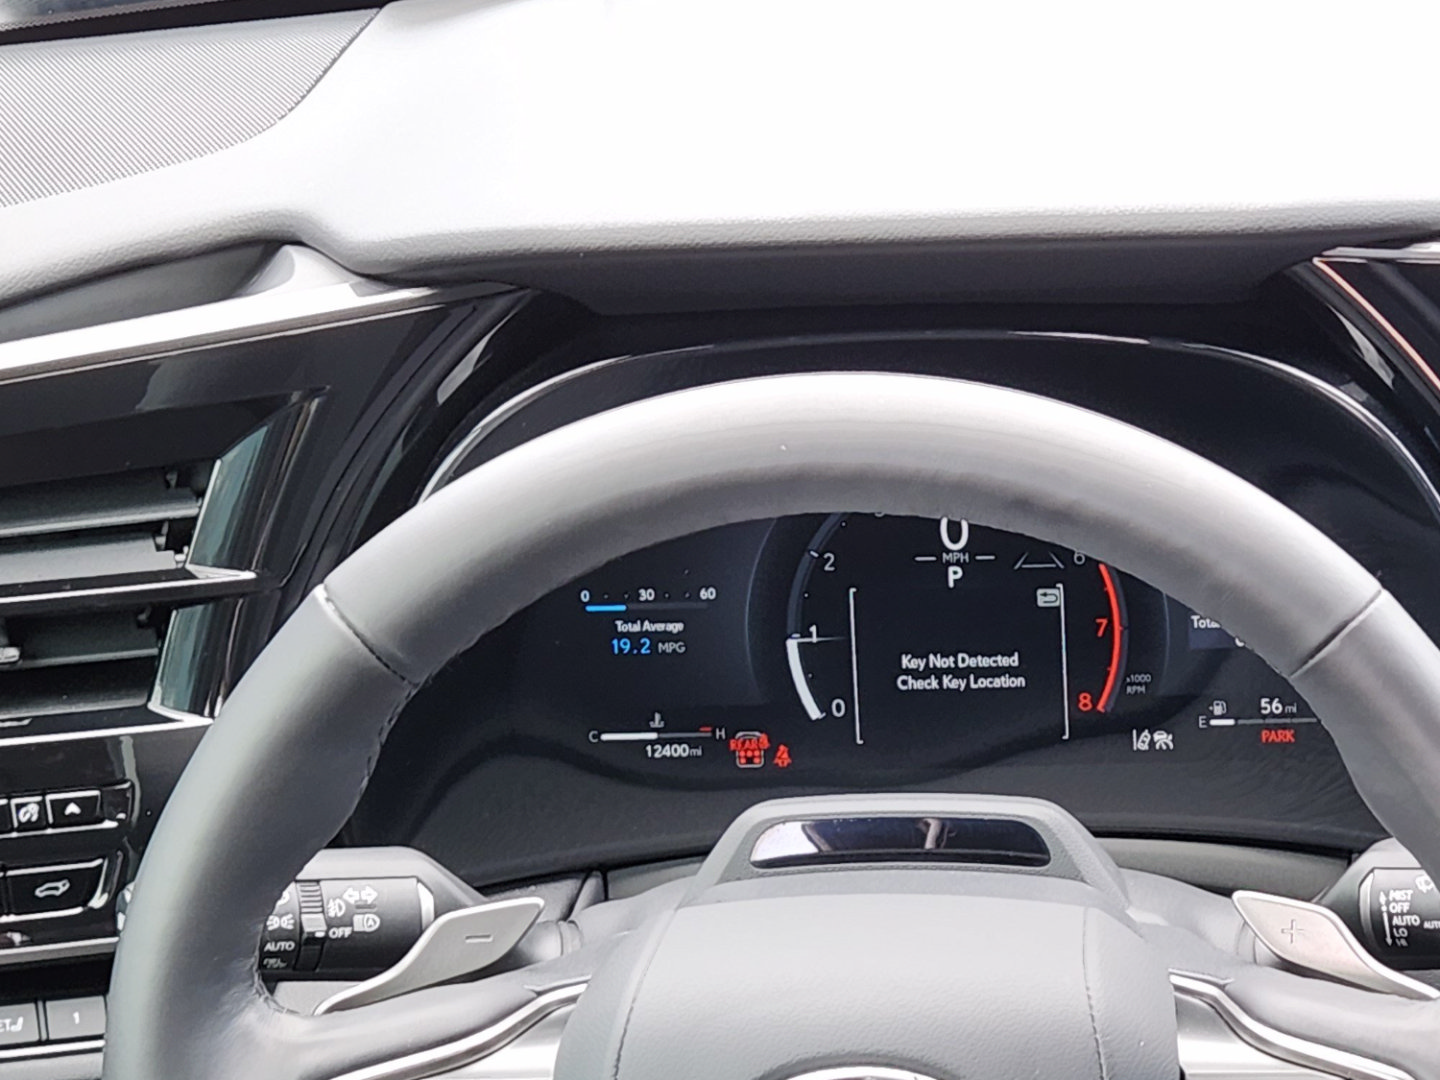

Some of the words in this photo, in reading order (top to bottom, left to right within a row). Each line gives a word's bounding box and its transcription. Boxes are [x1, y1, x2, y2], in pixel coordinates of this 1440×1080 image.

[823, 554, 836, 571] 2
[942, 553, 969, 563] MPH
[948, 566, 963, 588] P
[580, 590, 591, 602] 0
[638, 589, 655, 601] 30
[700, 587, 716, 600] 60
[614, 620, 641, 632] Total
[642, 620, 684, 634] Average
[809, 625, 818, 642] 1
[1096, 619, 1109, 638] 7
[611, 638, 651, 655] 19.2
[658, 642, 686, 653] MPG
[901, 654, 926, 672] Key
[928, 653, 955, 669] Not
[957, 652, 1020, 668] Detected
[897, 674, 939, 691] Check
[942, 674, 967, 692] Key
[969, 673, 1026, 689] Location
[1126, 685, 1146, 695] RPM
[832, 699, 845, 717] 0
[1078, 693, 1092, 711] 8
[1260, 698, 1283, 714] 56
[1285, 703, 1298, 713] mi
[1199, 716, 1208, 728] E
[588, 731, 598, 743] C
[716, 728, 726, 740] H
[1261, 729, 1295, 743] PARK
[1389, 902, 1410, 913] OFF
[1392, 915, 1420, 926] AUTO
[329, 927, 352, 938] OFF
[1393, 928, 1408, 937] LO
[264, 941, 295, 951] AUTO
[72, 1011, 80, 1024] 1
